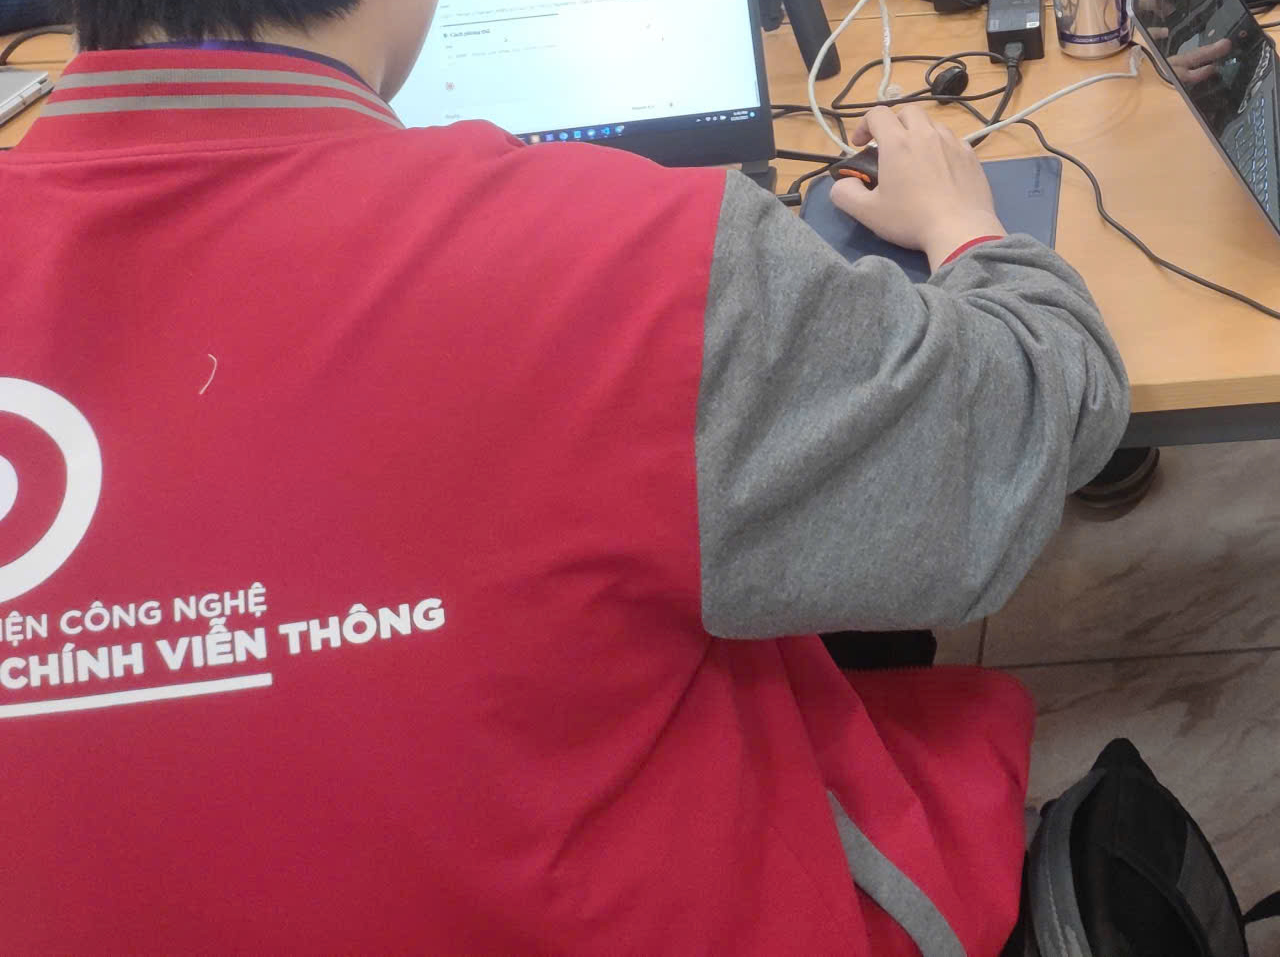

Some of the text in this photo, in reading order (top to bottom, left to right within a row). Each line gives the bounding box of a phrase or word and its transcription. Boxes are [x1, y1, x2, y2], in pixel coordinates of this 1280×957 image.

[0, 598, 446, 690] CHÍNH VIỄN THÔNG
[60, 601, 162, 635] CÔNG
[174, 582, 268, 623] NGHỆ
